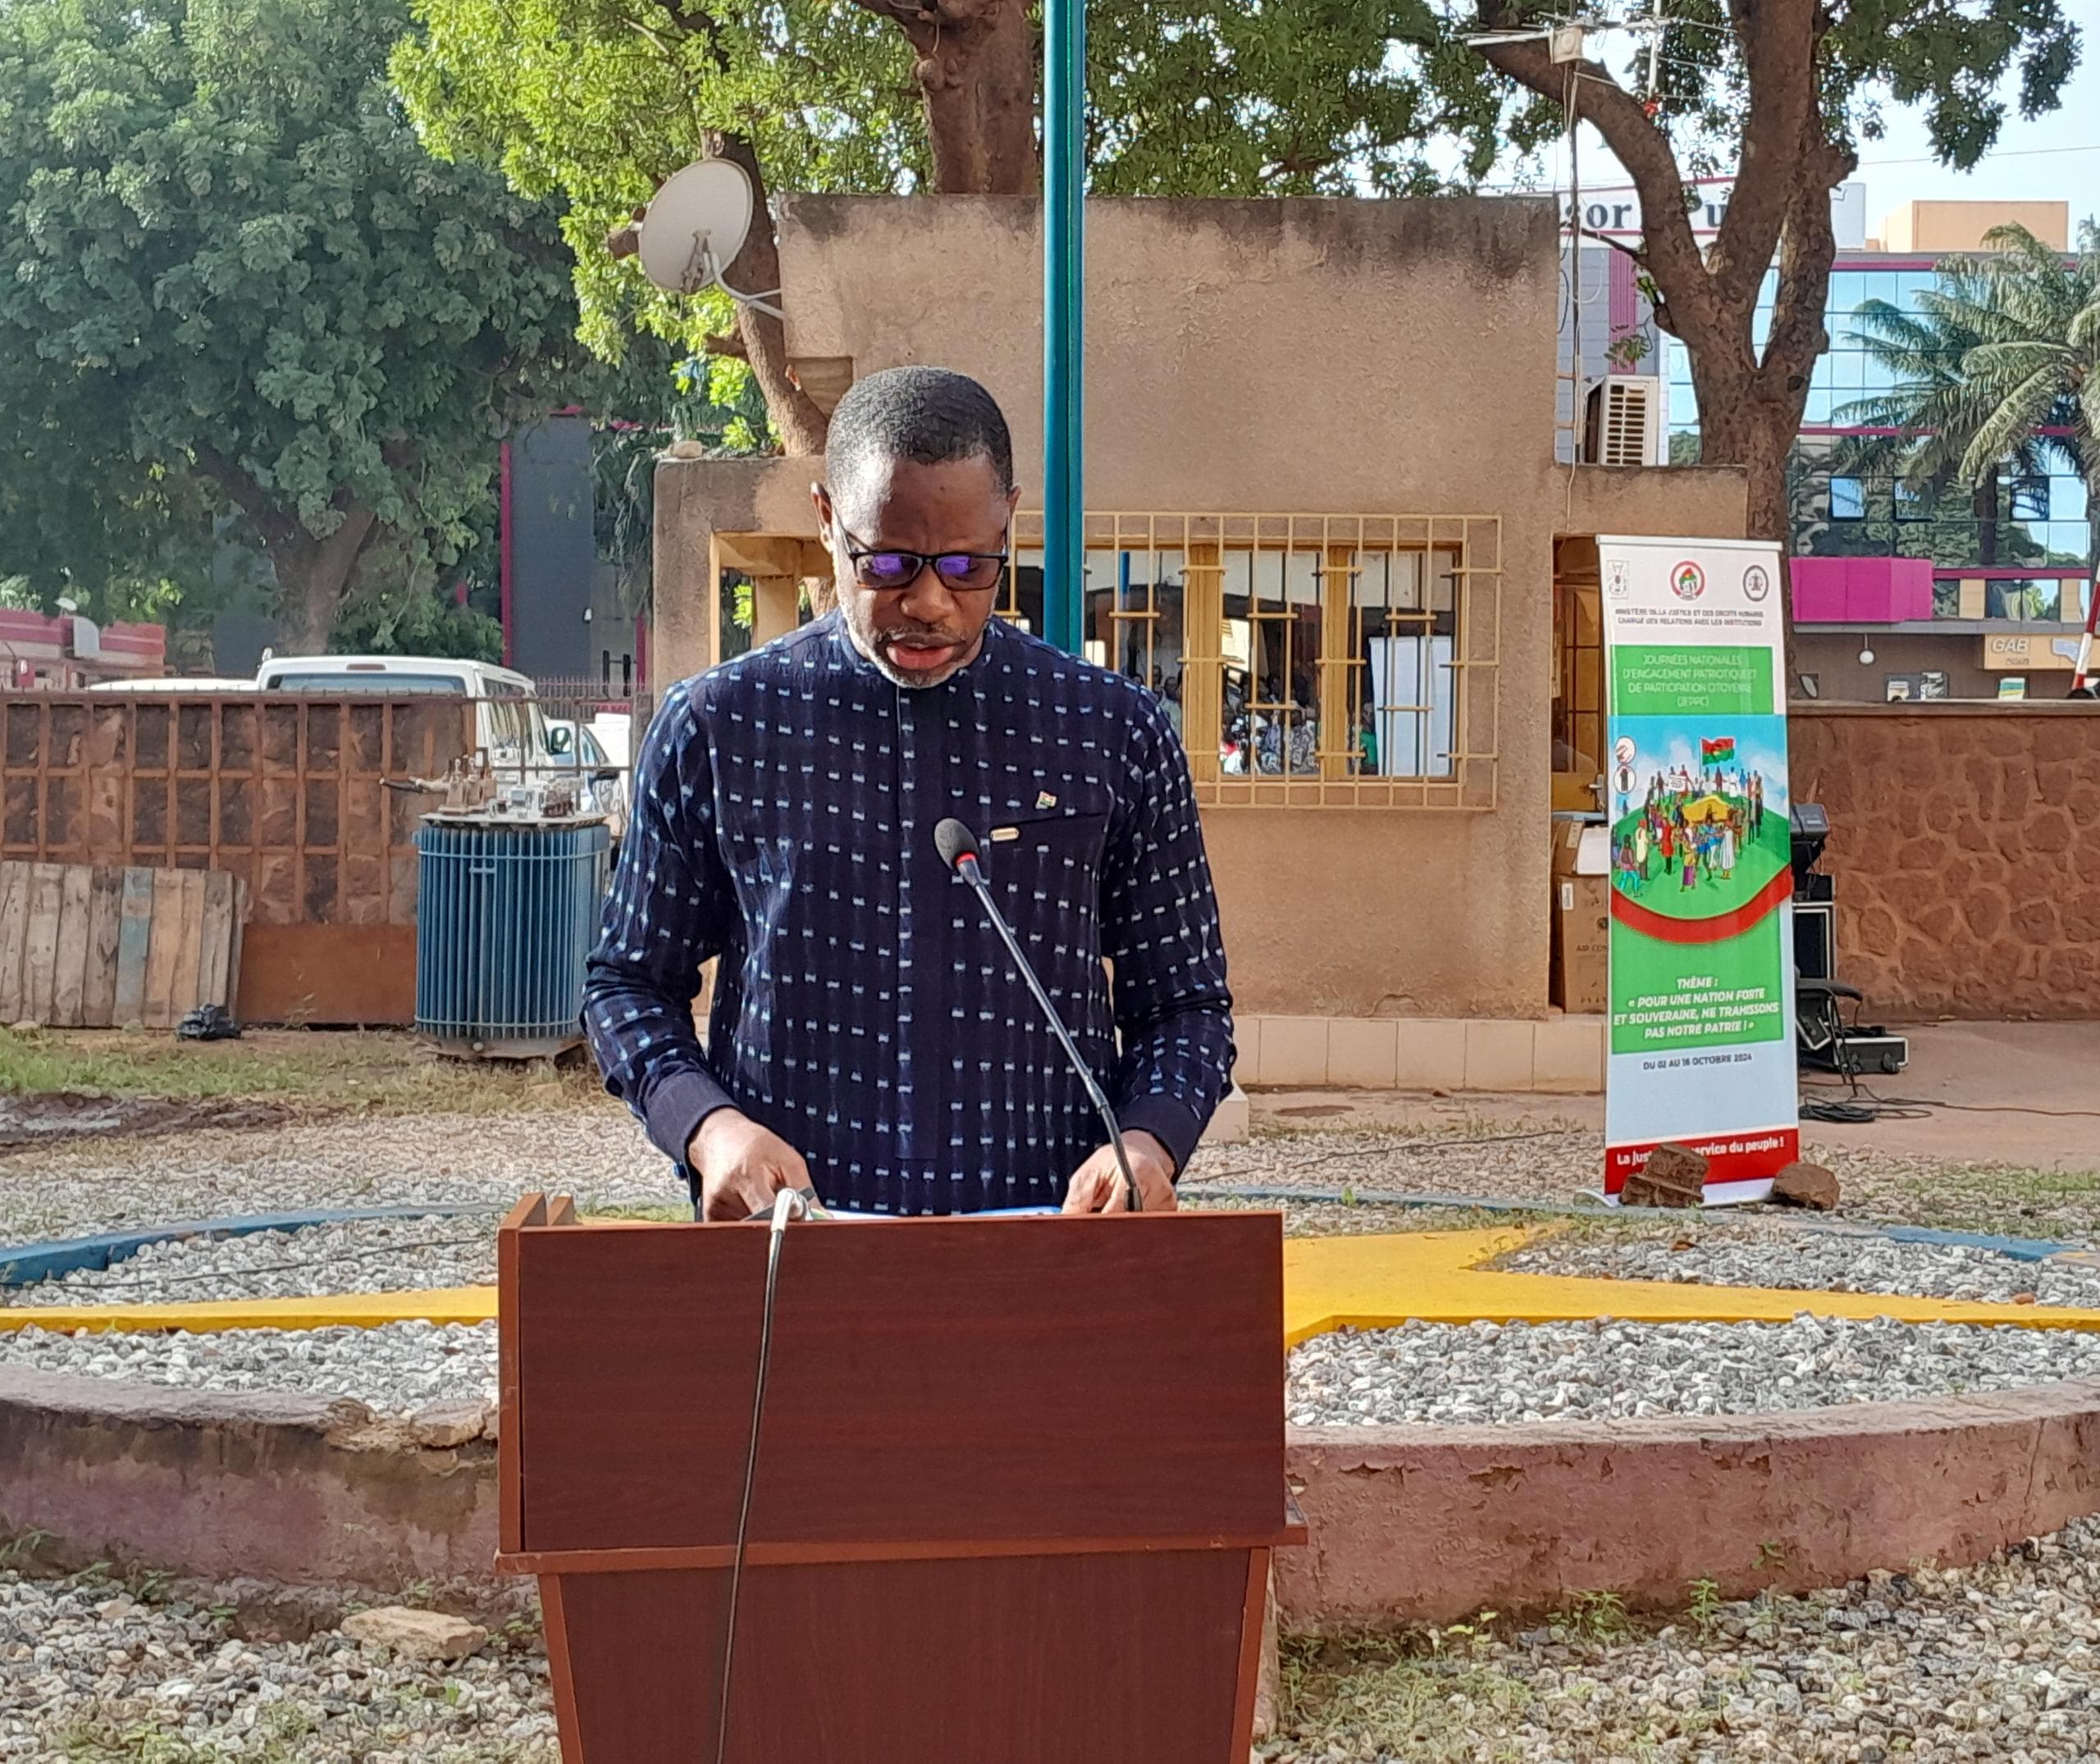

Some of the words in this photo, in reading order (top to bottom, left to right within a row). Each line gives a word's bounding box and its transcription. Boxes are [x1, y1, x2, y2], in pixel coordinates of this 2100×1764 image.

[1992, 636, 2029, 654] GAB
[1643, 653, 1687, 665] JOURNÉES
[1689, 654, 1742, 665] NATIONALES
[1628, 682, 1641, 693] DE
[1643, 682, 1706, 693] PARTICIPATION
[1637, 995, 1668, 1008] POUR
[1669, 993, 1691, 1005] UNE
[1692, 990, 1734, 1004] NATION
[1736, 987, 1765, 1001] FORTE
[1614, 1013, 1628, 1026] ET
[1701, 1006, 1717, 1019] NE
[1718, 1001, 1779, 1018] TRAHISSONS
[1644, 1026, 1665, 1039] PAS
[1667, 1023, 1702, 1037] NOTRE
[1704, 1020, 1742, 1034] PATRIE
[1643, 1060, 1655, 1070] DU
[1669, 1058, 1681, 1068] AU
[1692, 1055, 1732, 1065] OCTOBRE
[1617, 1152, 1631, 1165] La
[1691, 1142, 1727, 1156] ervice
[1729, 1139, 1744, 1154] du
[1745, 1136, 1779, 1155] peuple
